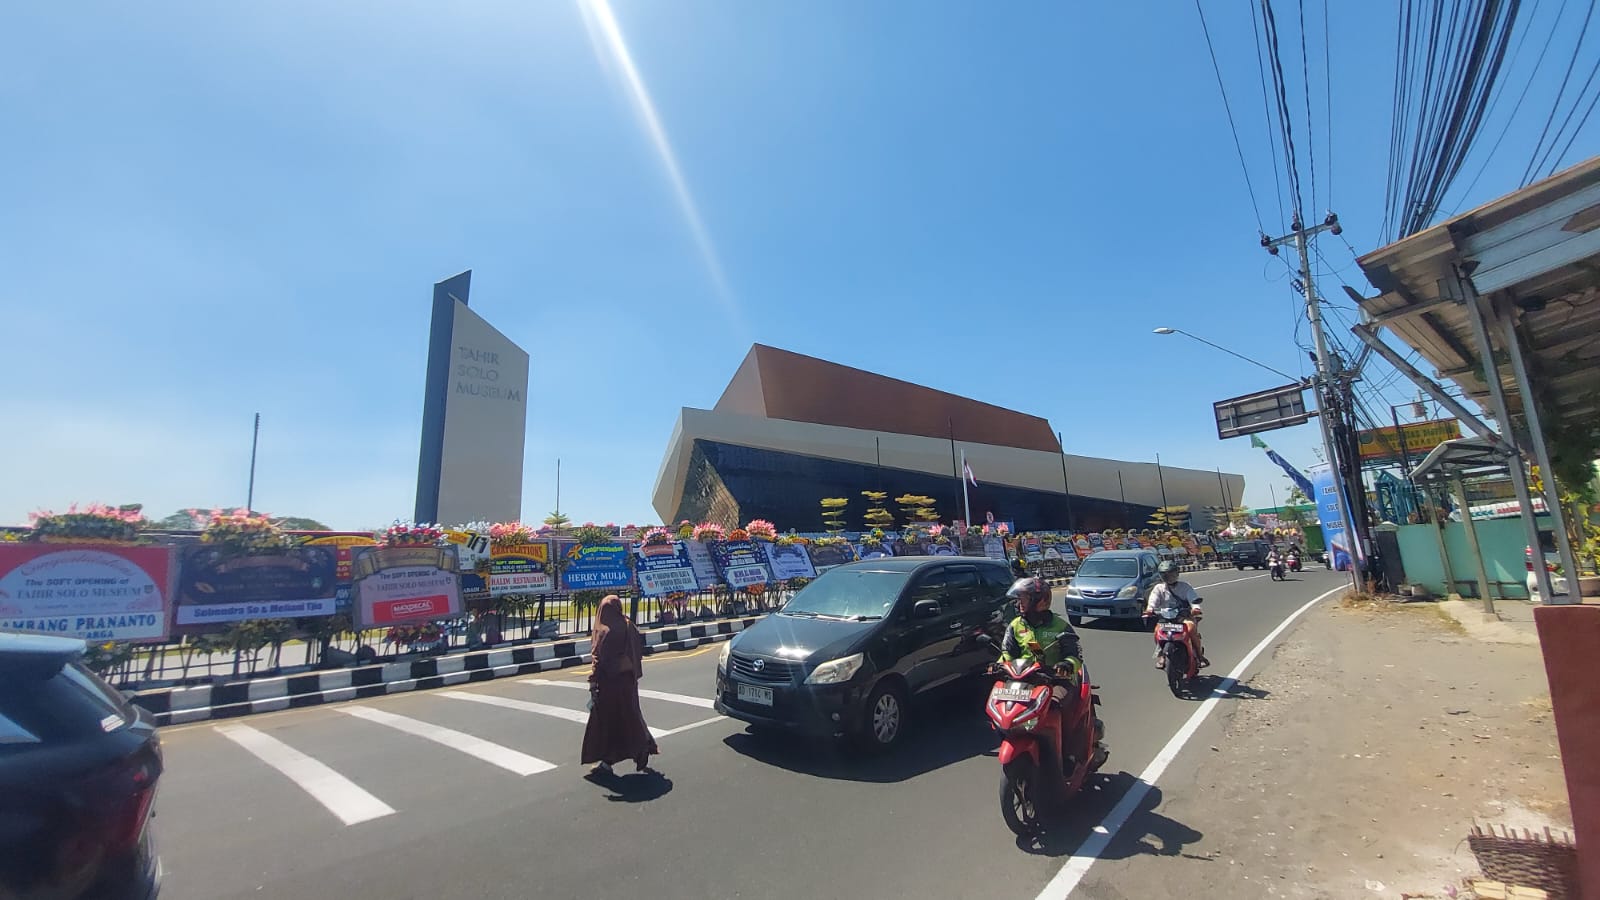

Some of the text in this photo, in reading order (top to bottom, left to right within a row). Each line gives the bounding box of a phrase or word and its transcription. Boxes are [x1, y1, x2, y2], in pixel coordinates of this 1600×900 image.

[458, 346, 499, 365] TAHIR
[457, 364, 498, 381] SOLO
[456, 381, 520, 401] MUSEUM
[568, 573, 598, 582] HERRY
[57, 587, 89, 598] SOLO
[92, 586, 141, 598] MUSEUM
[75, 614, 156, 630] PRANANTO
